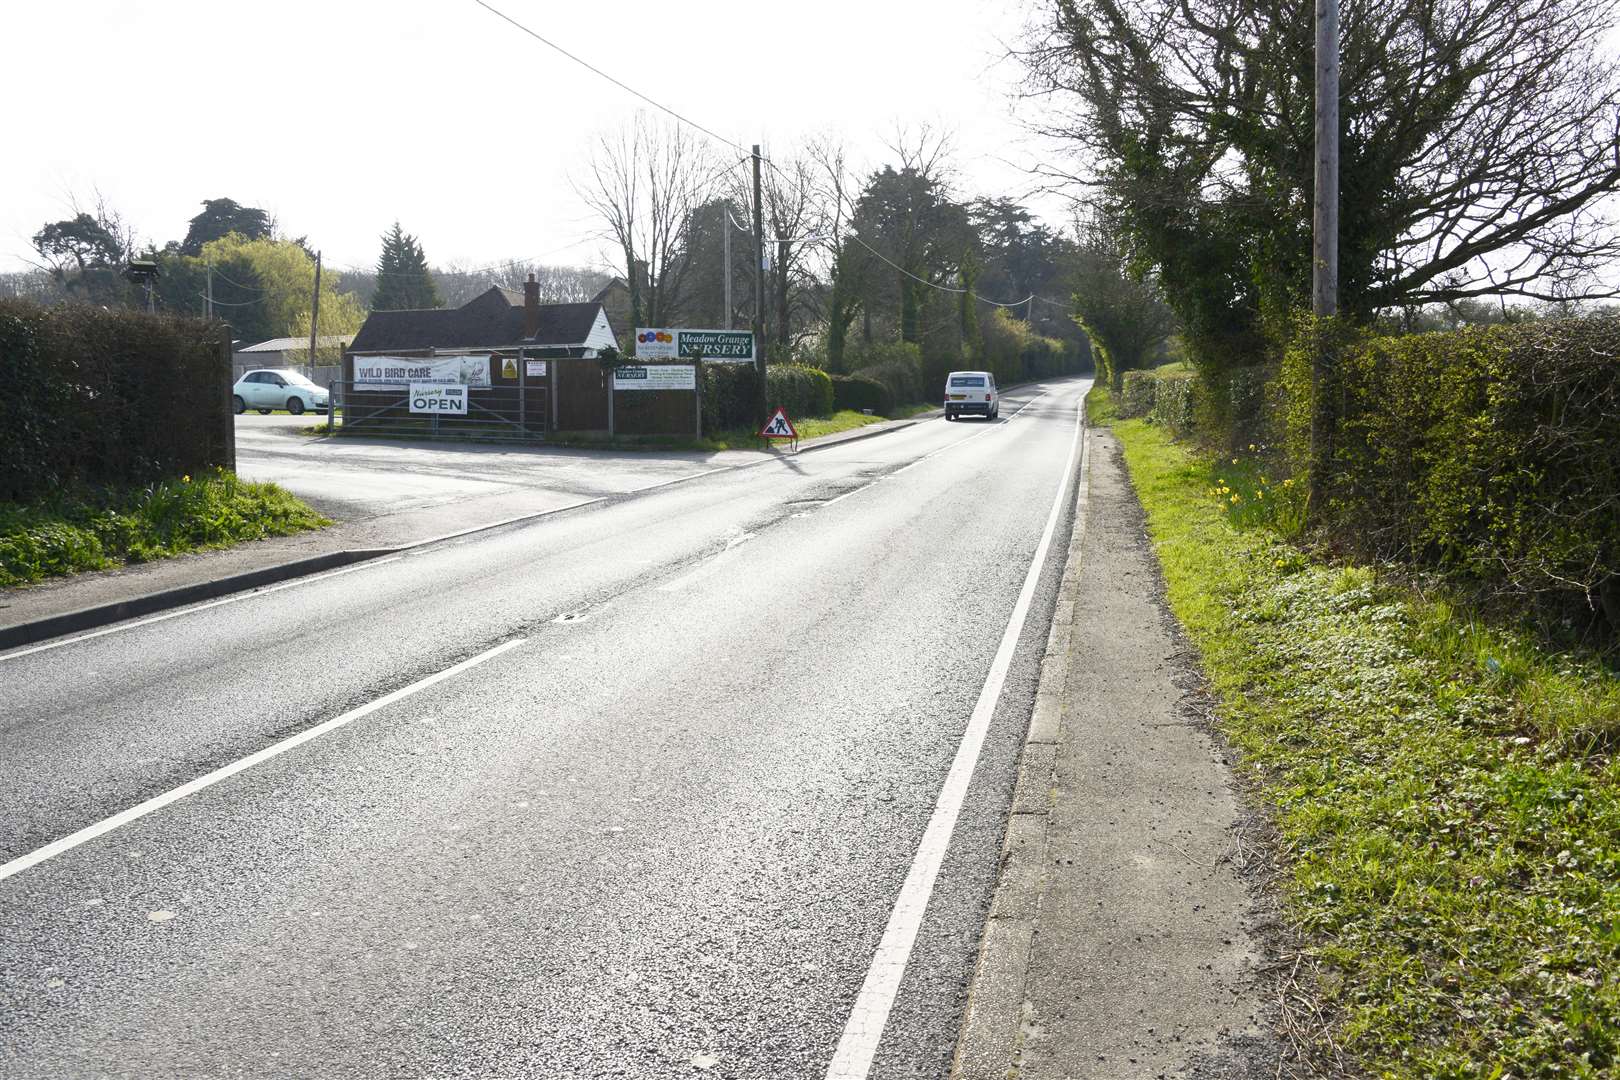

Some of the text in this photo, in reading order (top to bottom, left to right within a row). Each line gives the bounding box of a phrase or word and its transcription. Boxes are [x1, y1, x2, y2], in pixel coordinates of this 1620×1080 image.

[680, 334, 750, 345] Meadow Grange
[680, 344, 750, 354] NRSERY
[359, 368, 432, 378] WILD BIRD CARE
[413, 388, 442, 397] Nursery
[413, 398, 462, 410] OPEN
